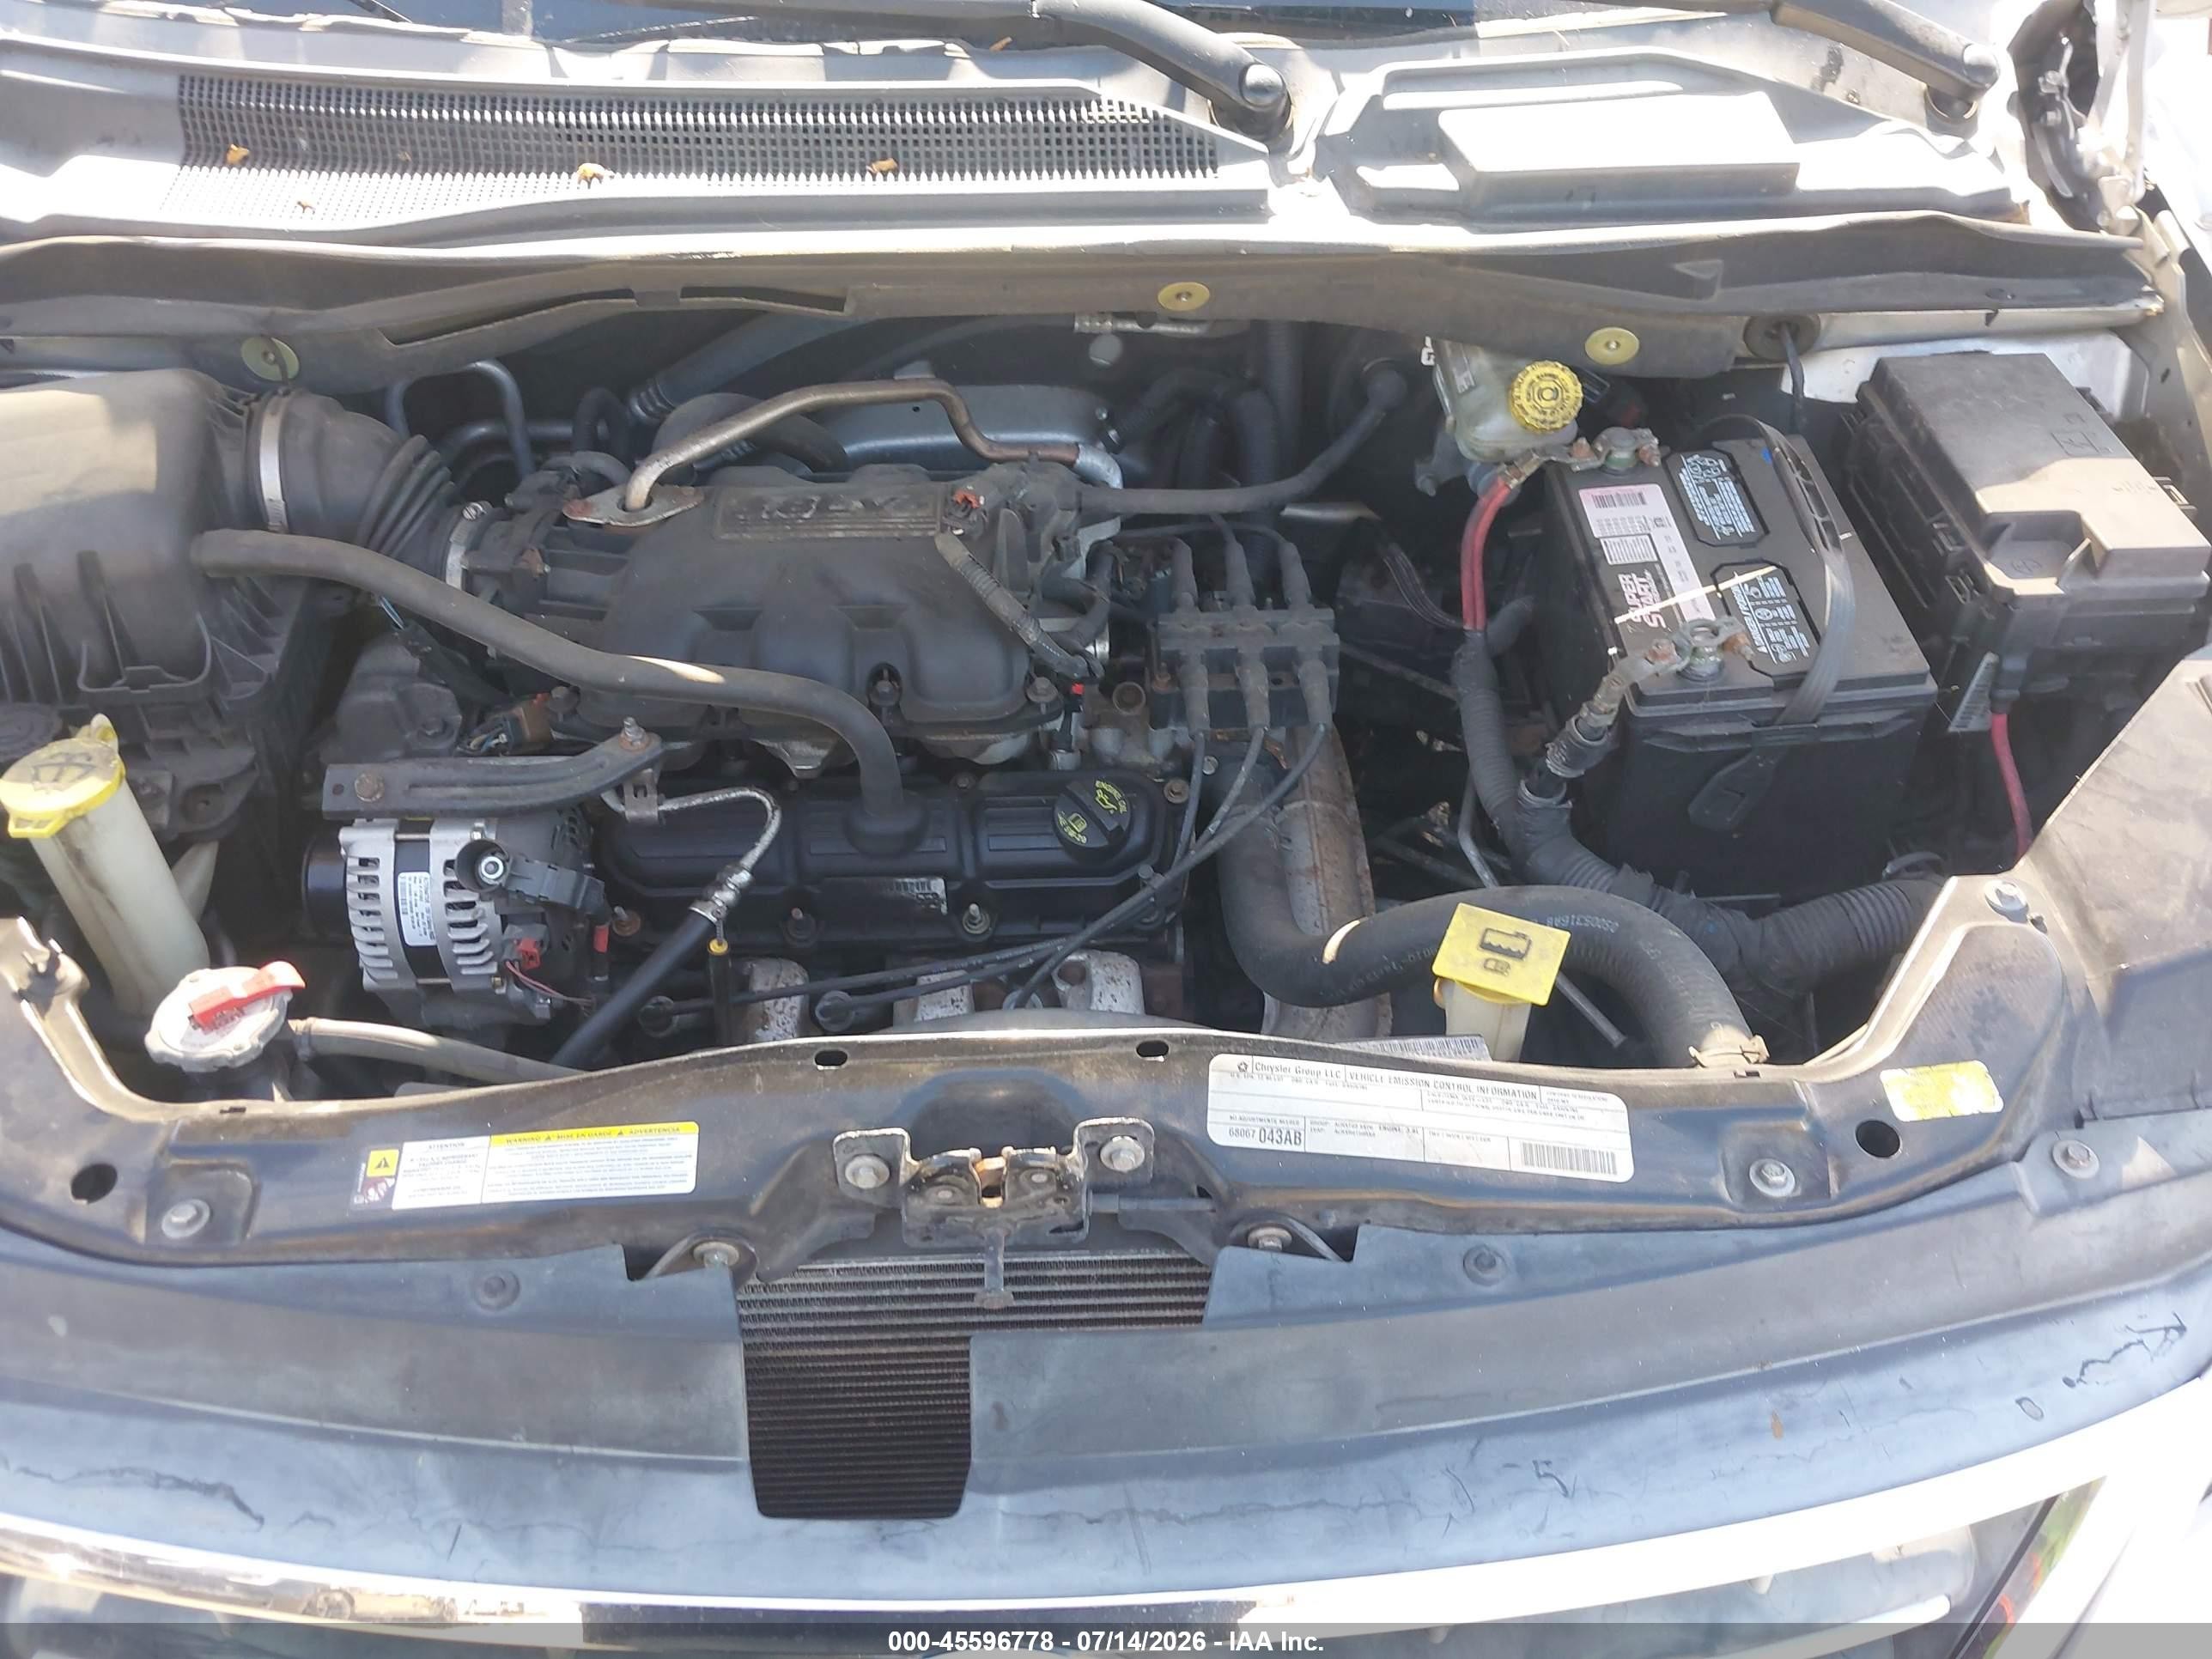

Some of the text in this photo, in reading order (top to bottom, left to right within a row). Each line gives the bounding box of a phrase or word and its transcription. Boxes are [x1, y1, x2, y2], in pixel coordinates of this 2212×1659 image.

[1255, 1061, 1291, 1073] Chrysler
[1295, 1066, 1322, 1079] Group
[1325, 1068, 1341, 1079] LLC
[1349, 1071, 1383, 1084] VEHICLE
[1389, 1076, 1430, 1088] EMISSION
[1433, 1079, 1474, 1093] CONTROL
[1477, 1085, 1537, 1100] INFORMATION
[506, 1135, 542, 1145] WARNING
[629, 1127, 681, 1136] ADVERTENCIA
[1229, 1127, 1302, 1146] 68067 043AB
